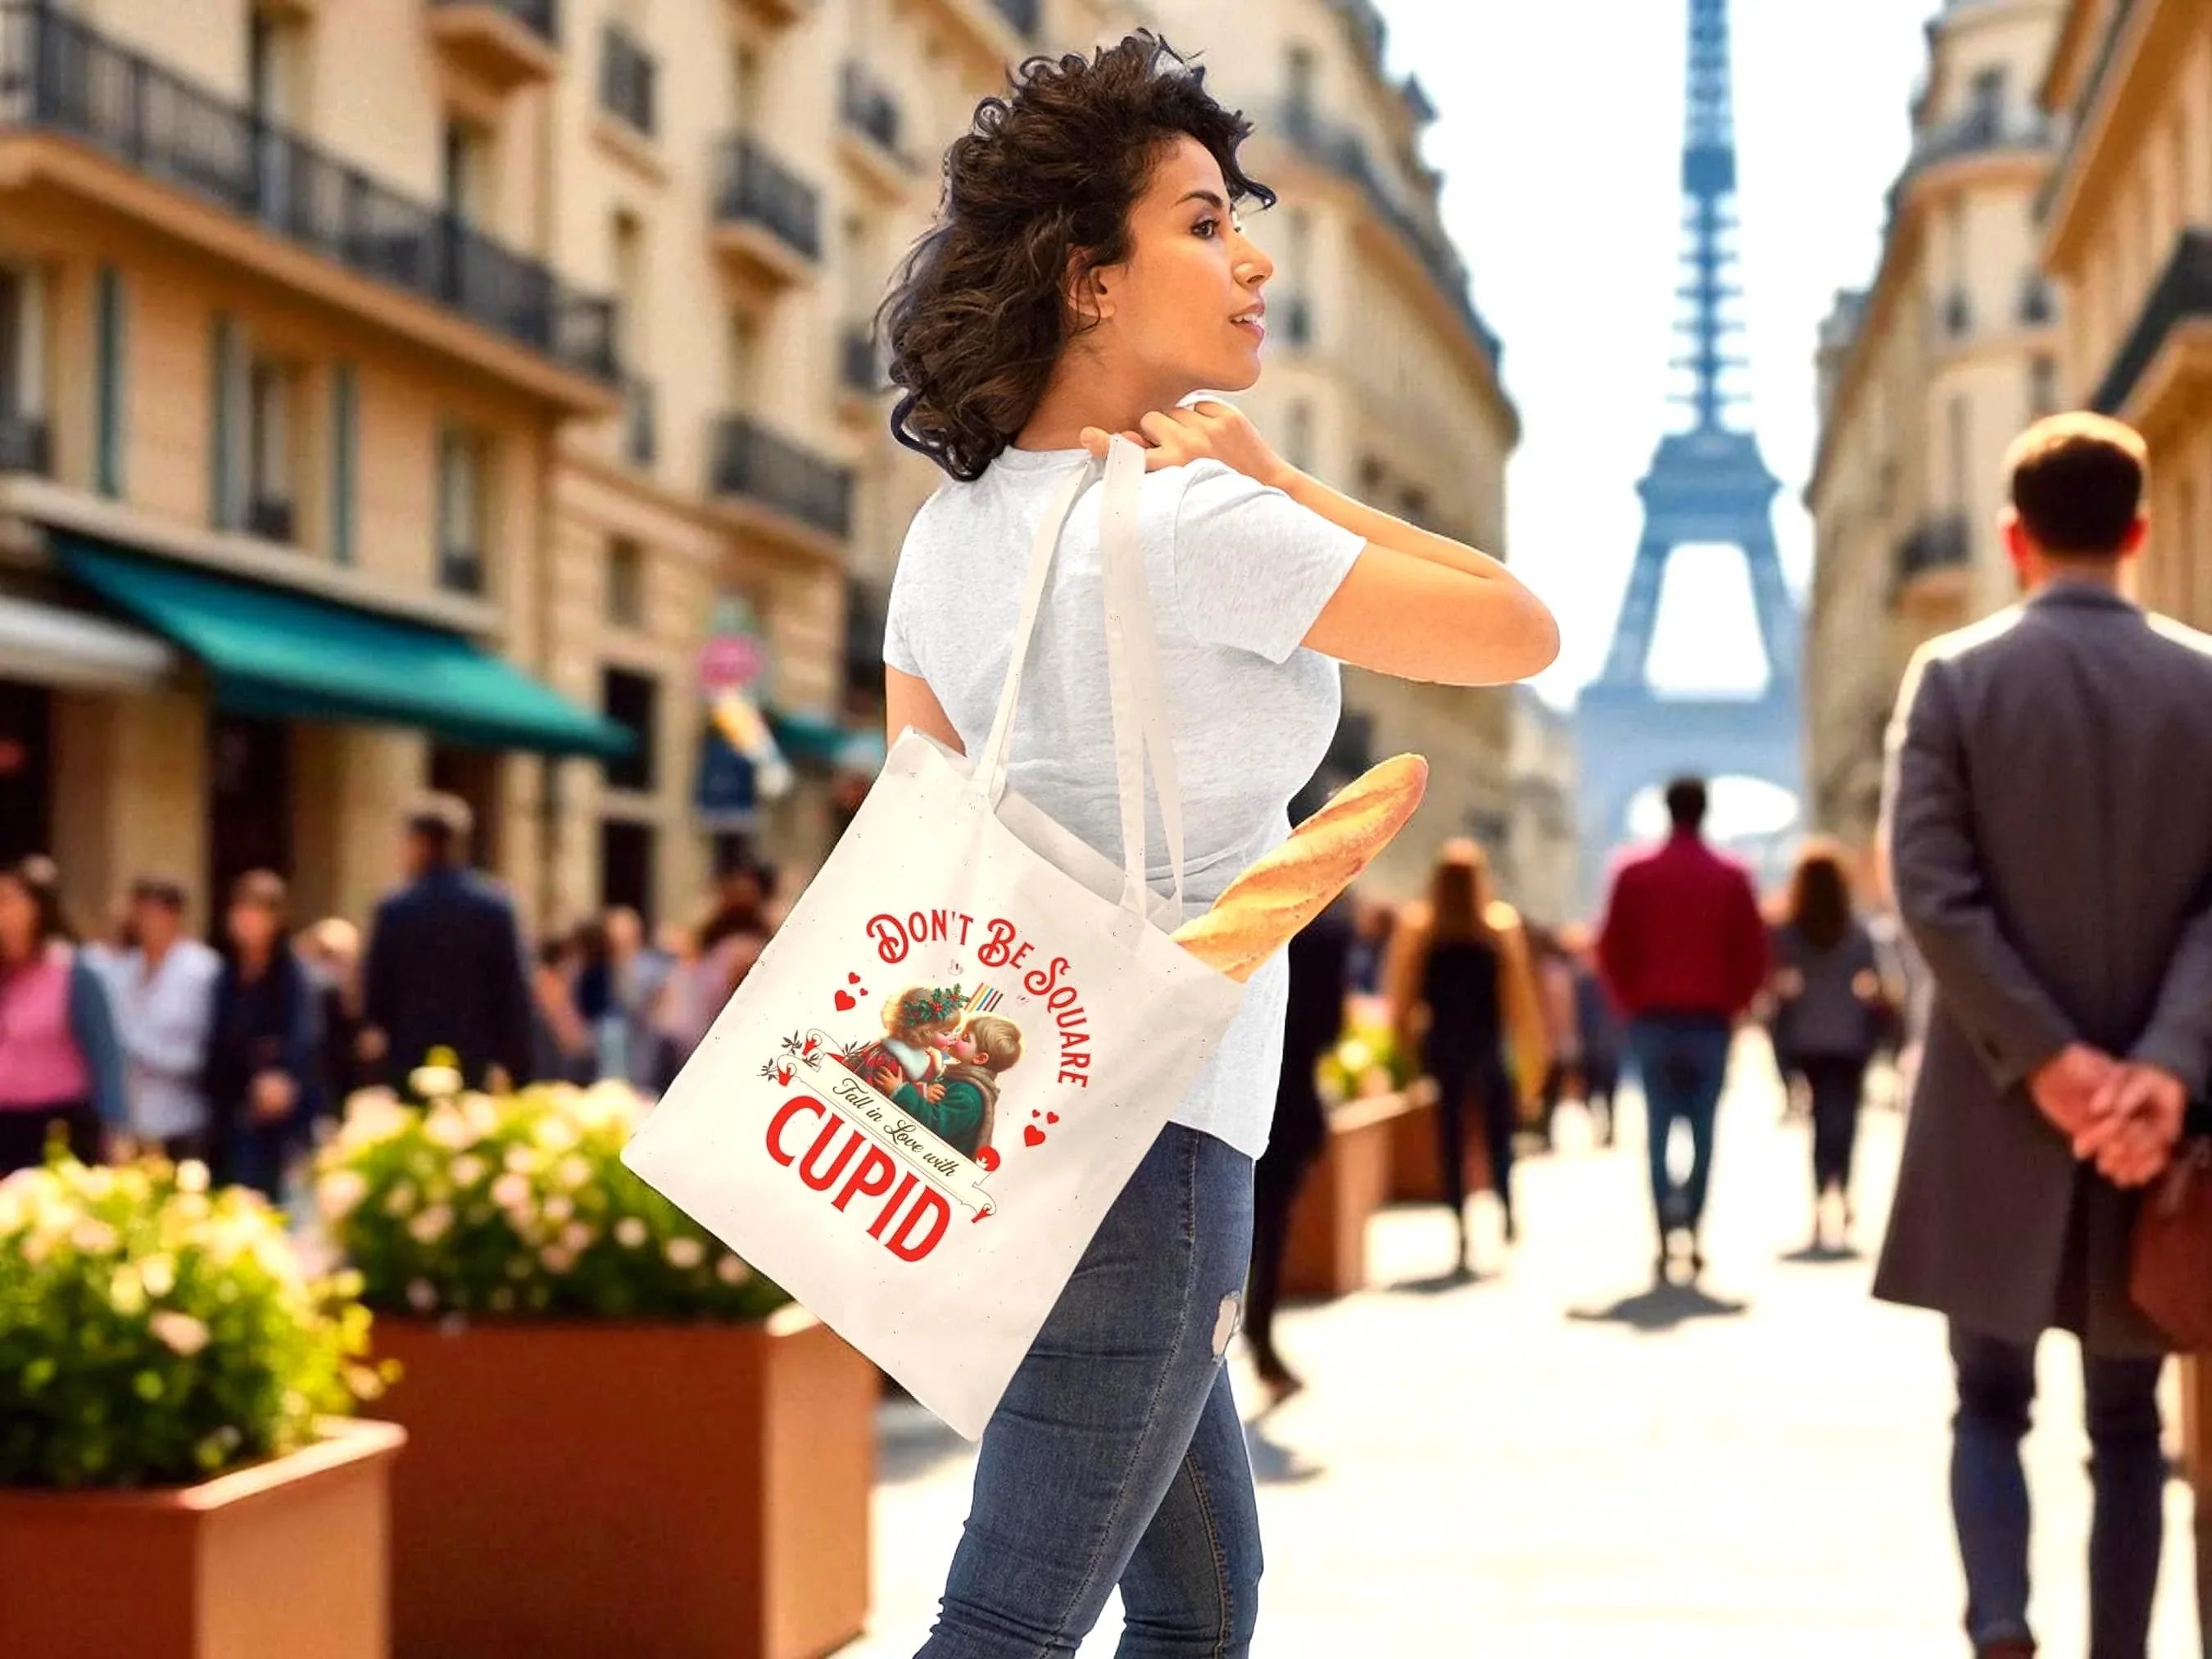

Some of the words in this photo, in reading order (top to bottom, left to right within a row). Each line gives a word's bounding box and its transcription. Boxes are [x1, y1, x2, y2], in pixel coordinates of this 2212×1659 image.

[866, 909, 974, 963] DON'T
[977, 918, 1035, 969] BE
[1023, 957, 1092, 1088] SQUARE
[766, 1095, 951, 1262] CUPID
[832, 1077, 873, 1109] Fall
[866, 1107, 883, 1122] in
[883, 1119, 924, 1152] Love
[923, 1151, 959, 1177] with
